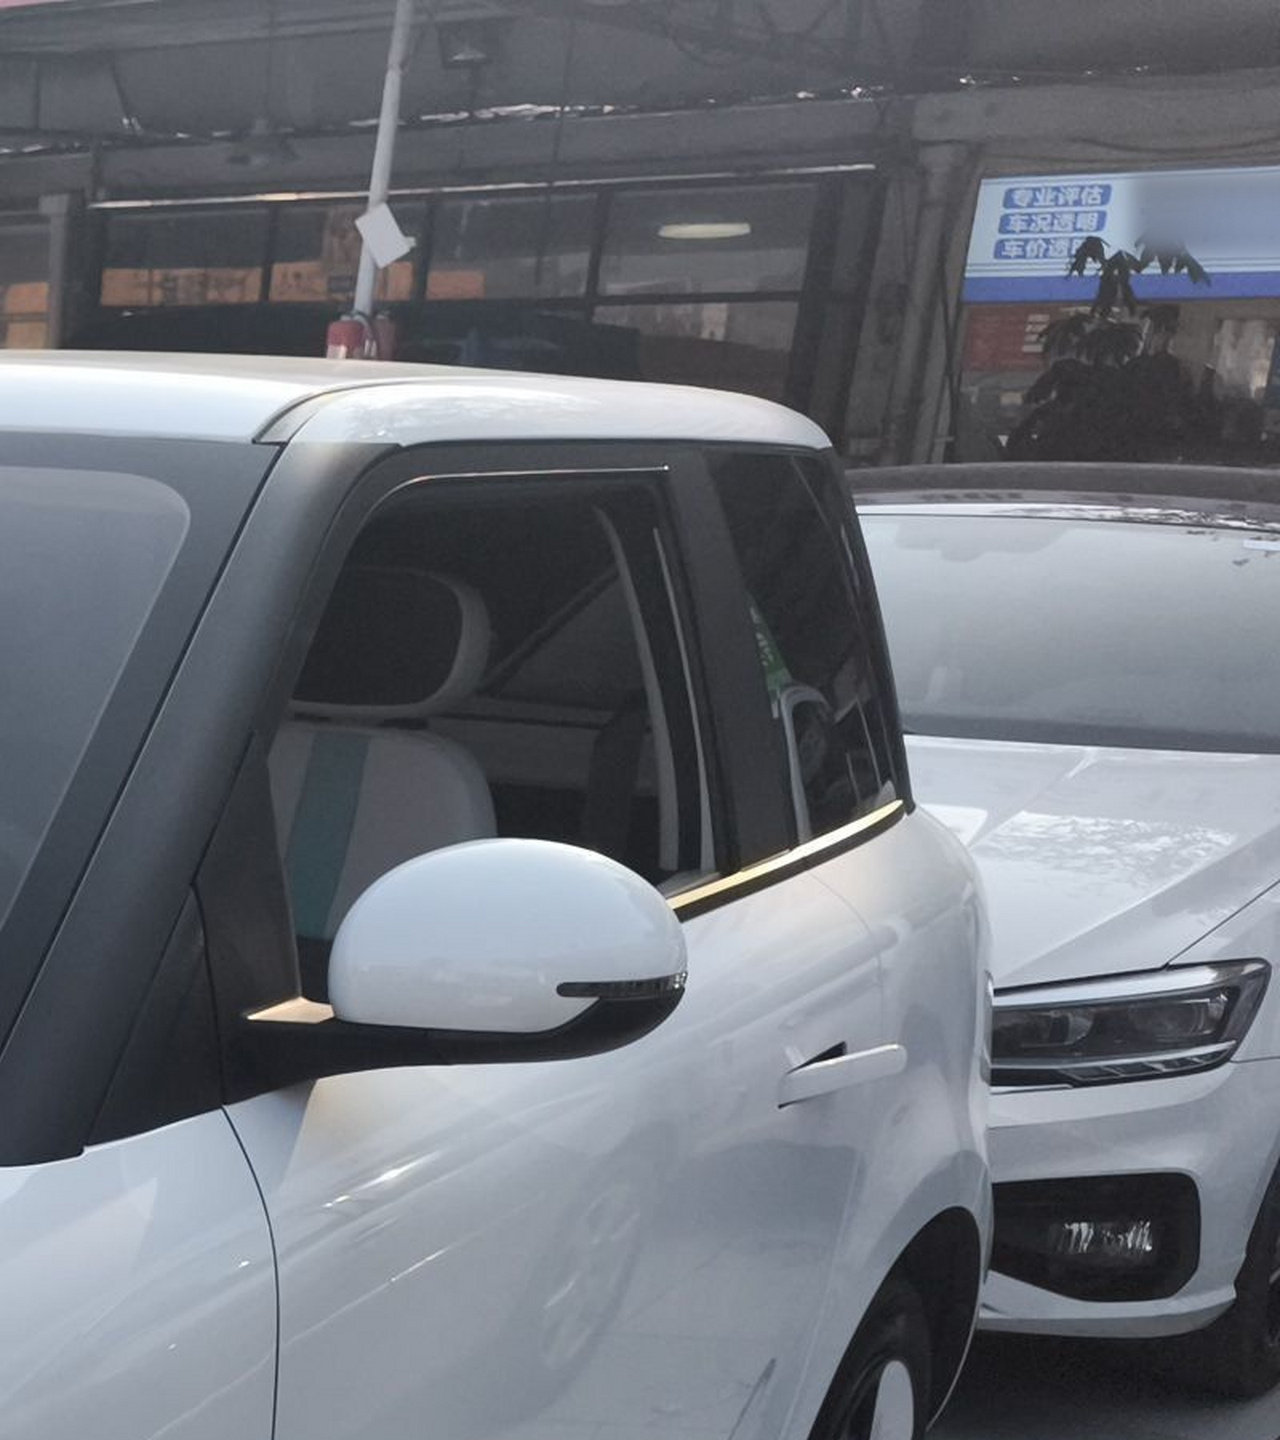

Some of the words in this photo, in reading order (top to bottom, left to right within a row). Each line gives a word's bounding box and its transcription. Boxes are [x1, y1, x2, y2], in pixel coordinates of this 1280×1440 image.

[1011, 185, 1104, 207] 专业评估
[1007, 212, 1099, 233] 车况透明
